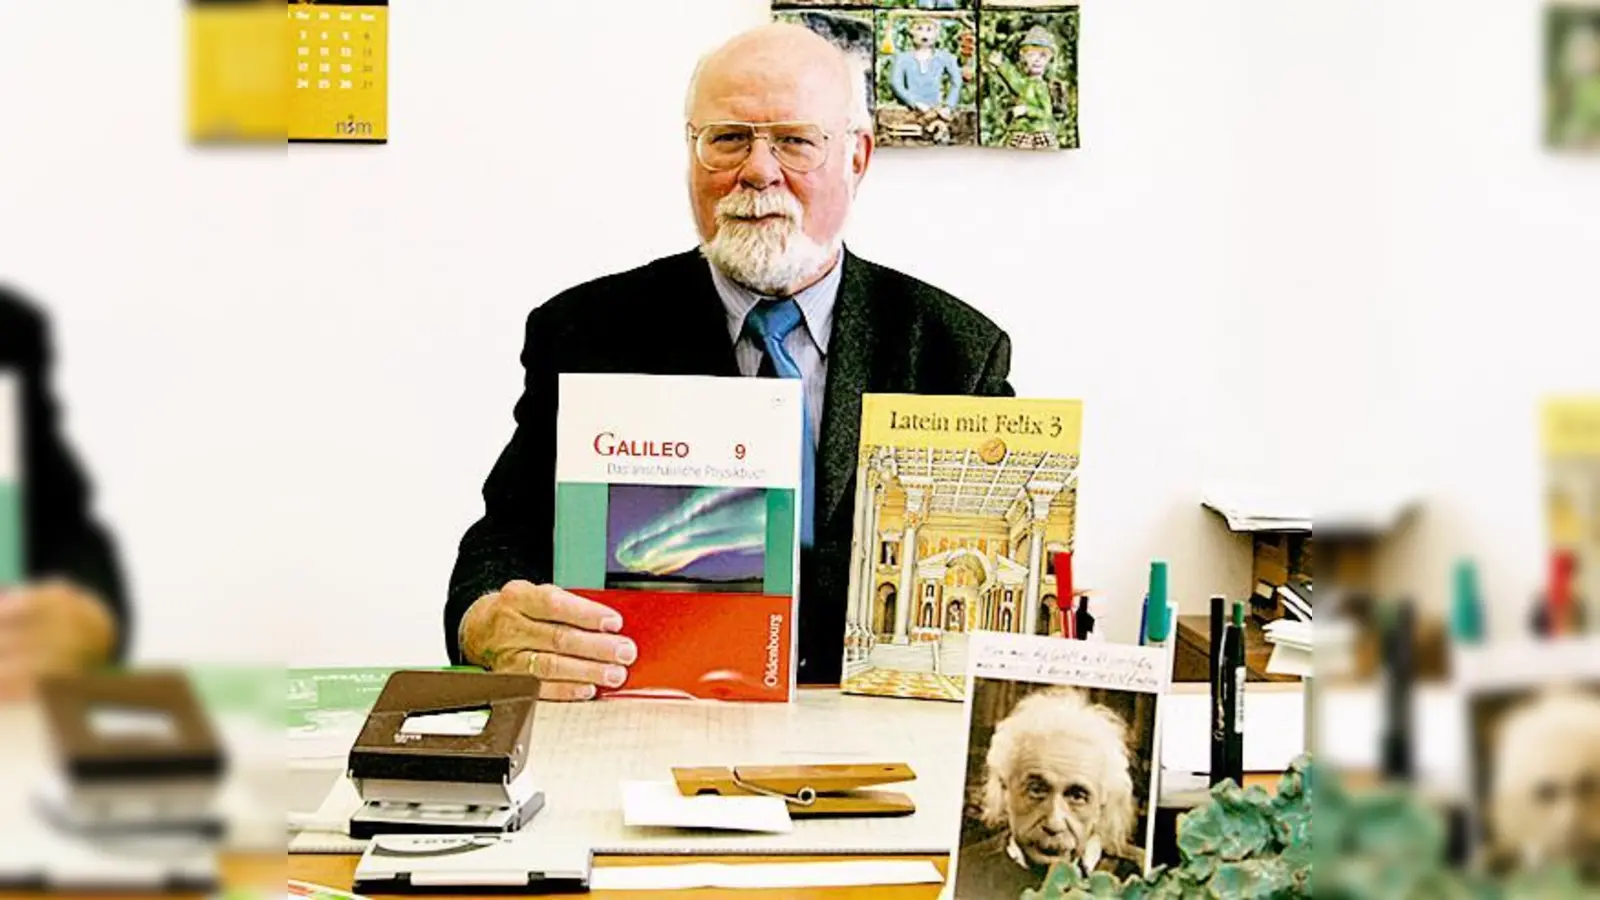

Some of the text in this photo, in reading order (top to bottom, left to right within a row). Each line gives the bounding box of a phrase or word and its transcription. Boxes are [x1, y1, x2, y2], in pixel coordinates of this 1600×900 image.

[890, 411, 1063, 438] Latein mit Felix 3
[735, 444, 746, 459] 9
[764, 613, 783, 687] Oldenbourg
